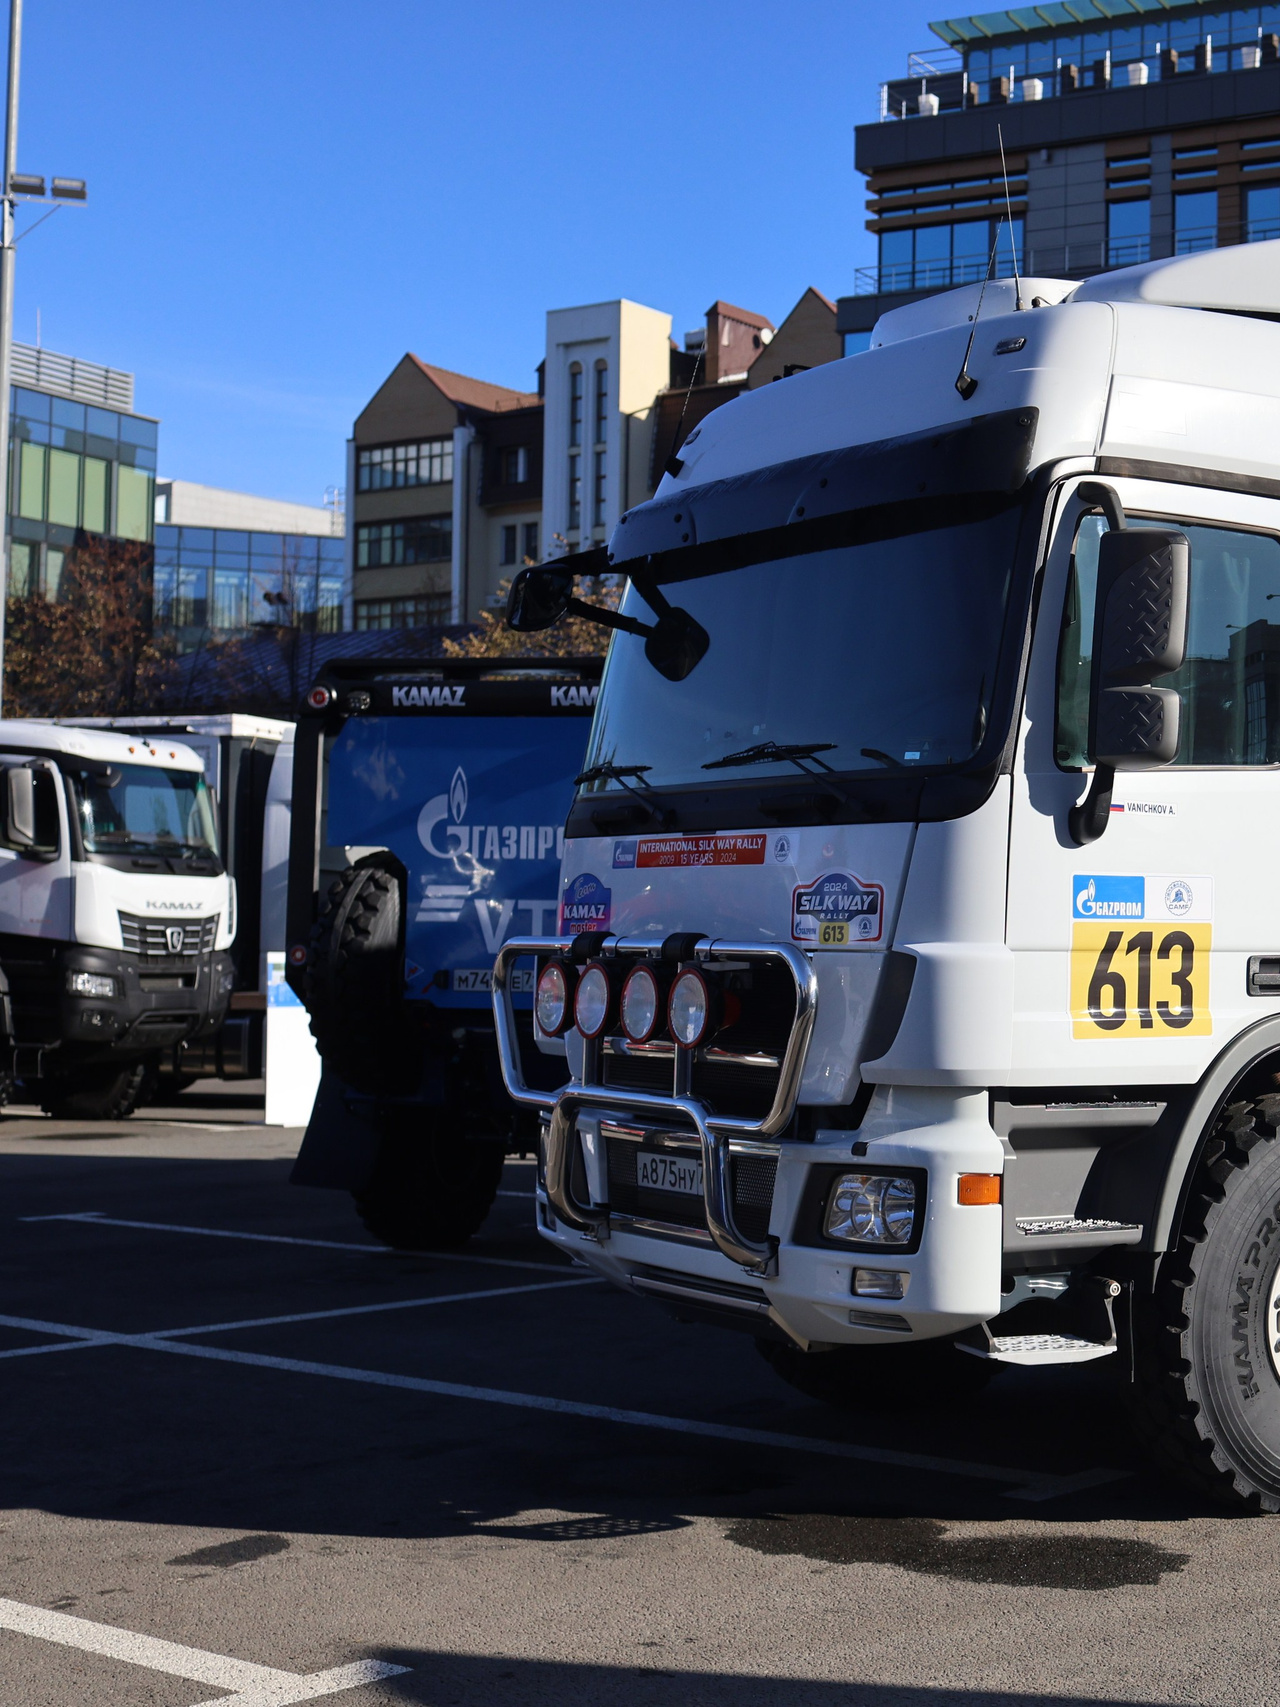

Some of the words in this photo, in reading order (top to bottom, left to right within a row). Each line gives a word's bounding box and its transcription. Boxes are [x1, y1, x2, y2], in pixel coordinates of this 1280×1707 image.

[392, 686, 466, 707] KAMAZ
[551, 686, 600, 707] KAM
[1127, 802, 1168, 814] VANICHKOV
[1168, 806, 1176, 815] A.
[472, 825, 565, 860] ГАЗПРО
[640, 839, 697, 853] INTERNATIONAL
[698, 838, 714, 851] SILK
[717, 838, 736, 849] WAY
[736, 837, 763, 849] RALLY
[659, 855, 675, 865] 2009
[680, 853, 688, 864] 15
[689, 852, 714, 865] YEARS
[720, 853, 737, 863] 2024
[823, 882, 848, 891] 2024
[146, 900, 203, 910] KAMAZ
[799, 894, 836, 911] SILK
[838, 894, 875, 911] WAY
[1096, 901, 1142, 916] GAZPROM
[563, 904, 606, 919] KAMAZ
[473, 899, 558, 954] VT
[570, 921, 597, 934] master
[822, 925, 845, 942] 613
[1087, 930, 1195, 1031] 613
[641, 1157, 696, 1190] А875НУ
[1232, 1276, 1260, 1400] KAMA
